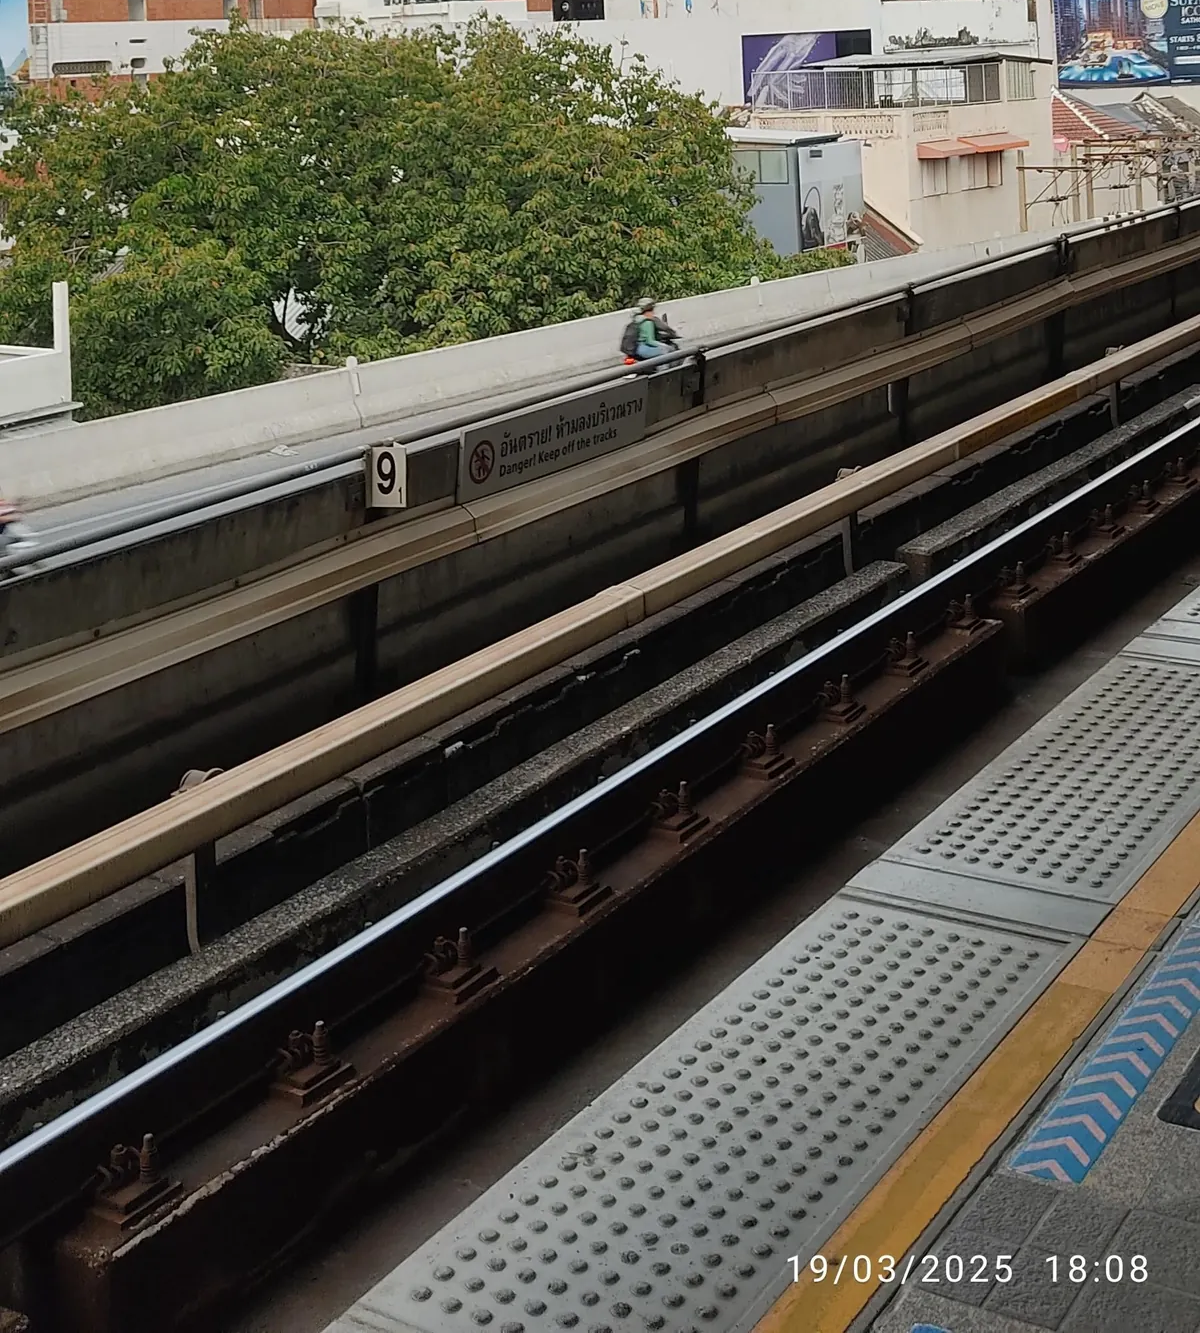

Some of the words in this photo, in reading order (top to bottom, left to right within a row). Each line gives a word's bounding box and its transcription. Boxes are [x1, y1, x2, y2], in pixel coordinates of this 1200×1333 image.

[500, 425, 552, 458] อันตราย!
[556, 397, 643, 439] ห้ามลงบริเวณราง
[376, 450, 397, 495] 9
[499, 452, 536, 478] Danger!
[538, 448, 560, 465] Keep
[562, 440, 575, 456] off
[577, 436, 591, 451] the
[593, 428, 617, 446] tracks
[398, 486, 403, 504] 1
